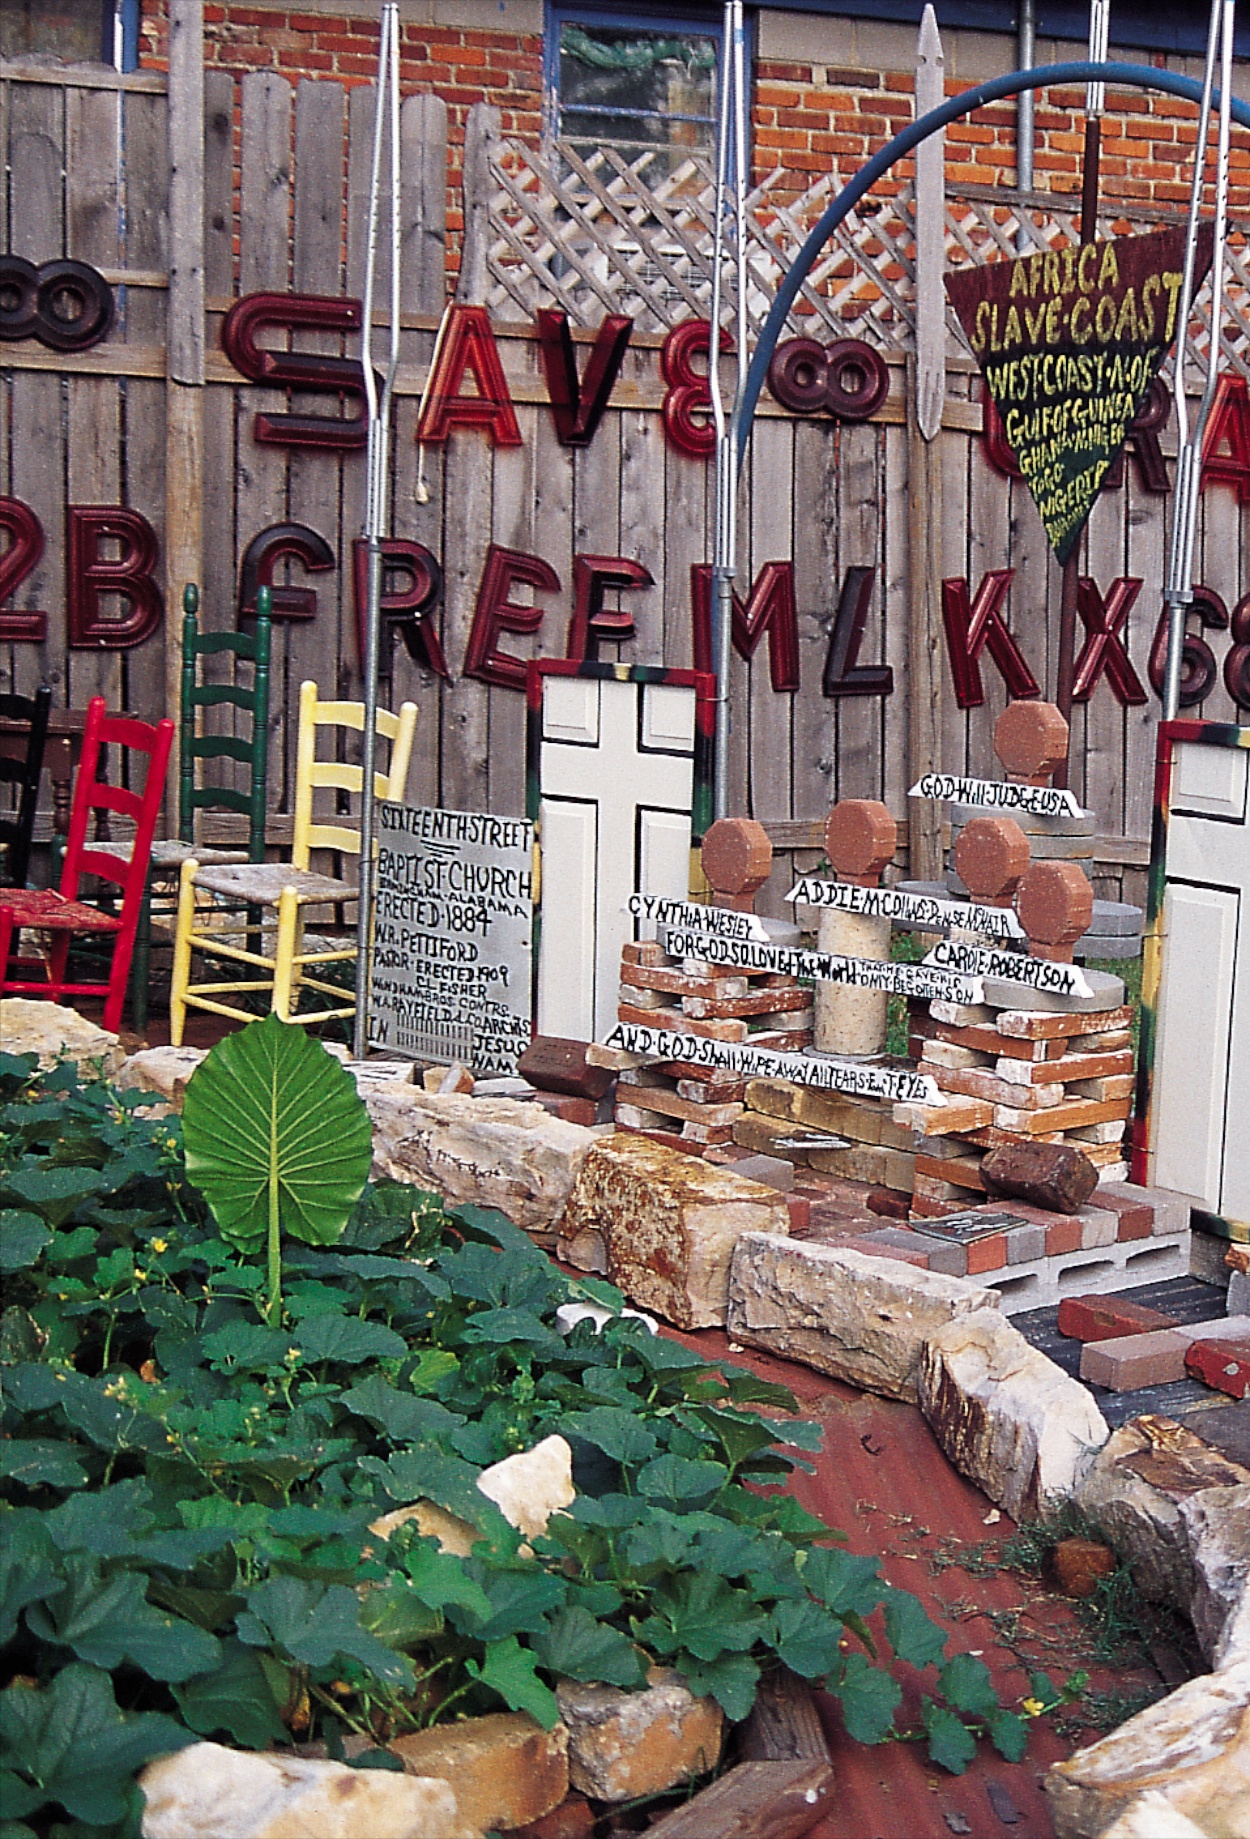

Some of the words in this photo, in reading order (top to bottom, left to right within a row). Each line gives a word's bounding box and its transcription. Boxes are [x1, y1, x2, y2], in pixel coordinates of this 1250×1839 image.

[1009, 242, 1120, 298] AFRICA
[970, 296, 1062, 352] SLAVE
[1070, 270, 1184, 345] COAST
[986, 353, 1041, 402] WEST
[1043, 350, 1107, 396] COAST
[1006, 406, 1051, 448] GULF
[1073, 393, 1136, 428] GUINEA
[921, 774, 955, 799] GOD
[987, 783, 1039, 812] JUDGE
[1040, 791, 1074, 818] USA
[381, 804, 466, 841] SIXTEENTH
[468, 815, 533, 852] STREET
[378, 848, 448, 889] BAPTIST
[450, 861, 532, 899] CHURCH
[376, 891, 440, 928] ERECTED
[446, 904, 493, 937] 1884
[450, 892, 529, 919] ALABAMA
[629, 896, 700, 929] CYNTHIA
[798, 879, 860, 913] ADDIE
[374, 946, 410, 970] PASTOR
[416, 959, 475, 982] ERECTED
[477, 965, 509, 987] 1909
[401, 929, 479, 962] PETTIFORD
[667, 931, 694, 956] FOR
[696, 935, 728, 962] GOD
[988, 951, 1076, 995] ROBERTSON
[367, 1016, 389, 1043] IN
[605, 1024, 652, 1051] AND
[658, 1033, 698, 1060] GOD
[472, 1052, 514, 1075] NAM
